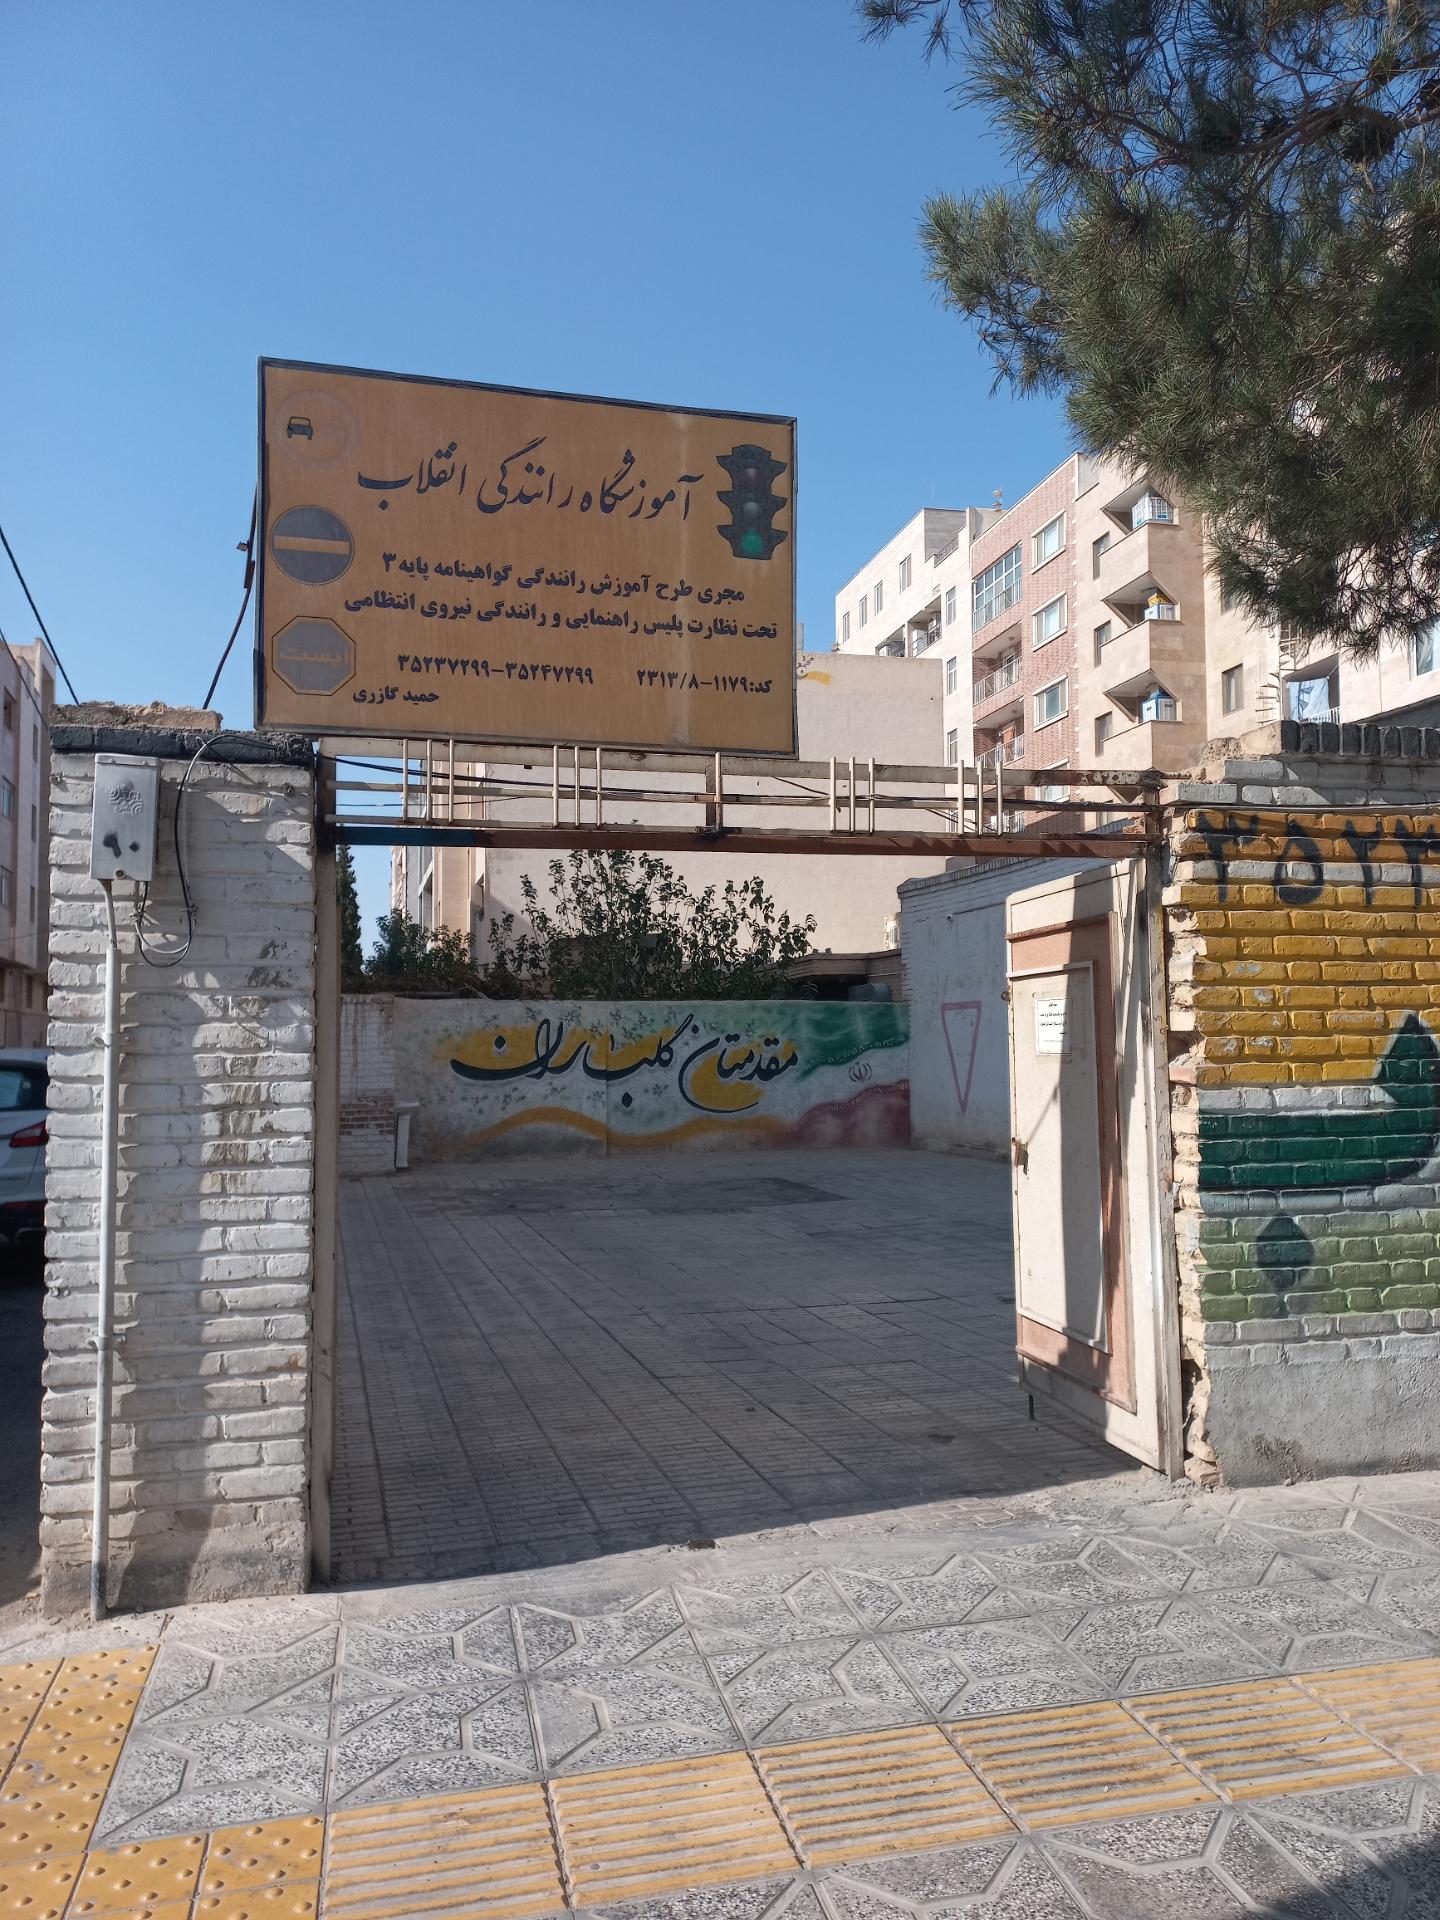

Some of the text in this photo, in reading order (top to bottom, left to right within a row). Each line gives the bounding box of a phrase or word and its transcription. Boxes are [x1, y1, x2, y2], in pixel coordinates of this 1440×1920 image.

[357, 434, 705, 521] آموزشگاه رانندگی انقلاب
[382, 551, 745, 605] مجری طرح آموزش رانندگی گواهینامه پایه ۳
[344, 590, 778, 640] تحت نظارت پلیس راهنمایی و رانندگی نیروی انتظامی
[402, 690, 439, 705] حمید
